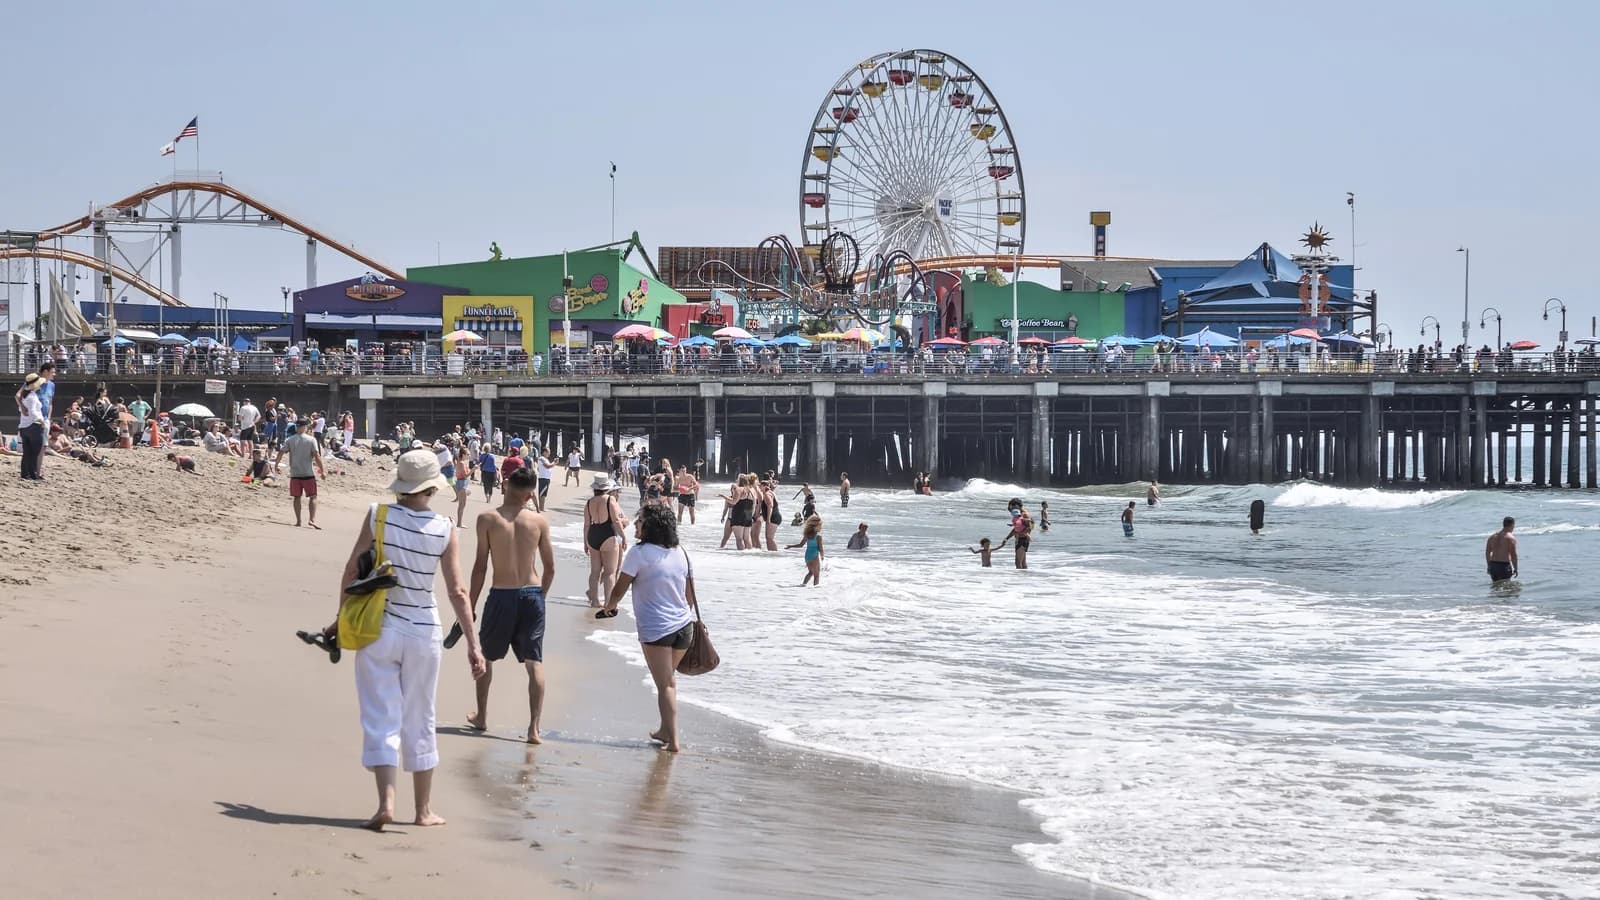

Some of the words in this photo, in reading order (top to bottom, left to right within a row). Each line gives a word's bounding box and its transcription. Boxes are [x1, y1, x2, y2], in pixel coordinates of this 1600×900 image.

[939, 199, 952, 208] PACIFIC
[941, 208, 950, 216] PARK
[463, 305, 492, 316] FUNNEL
